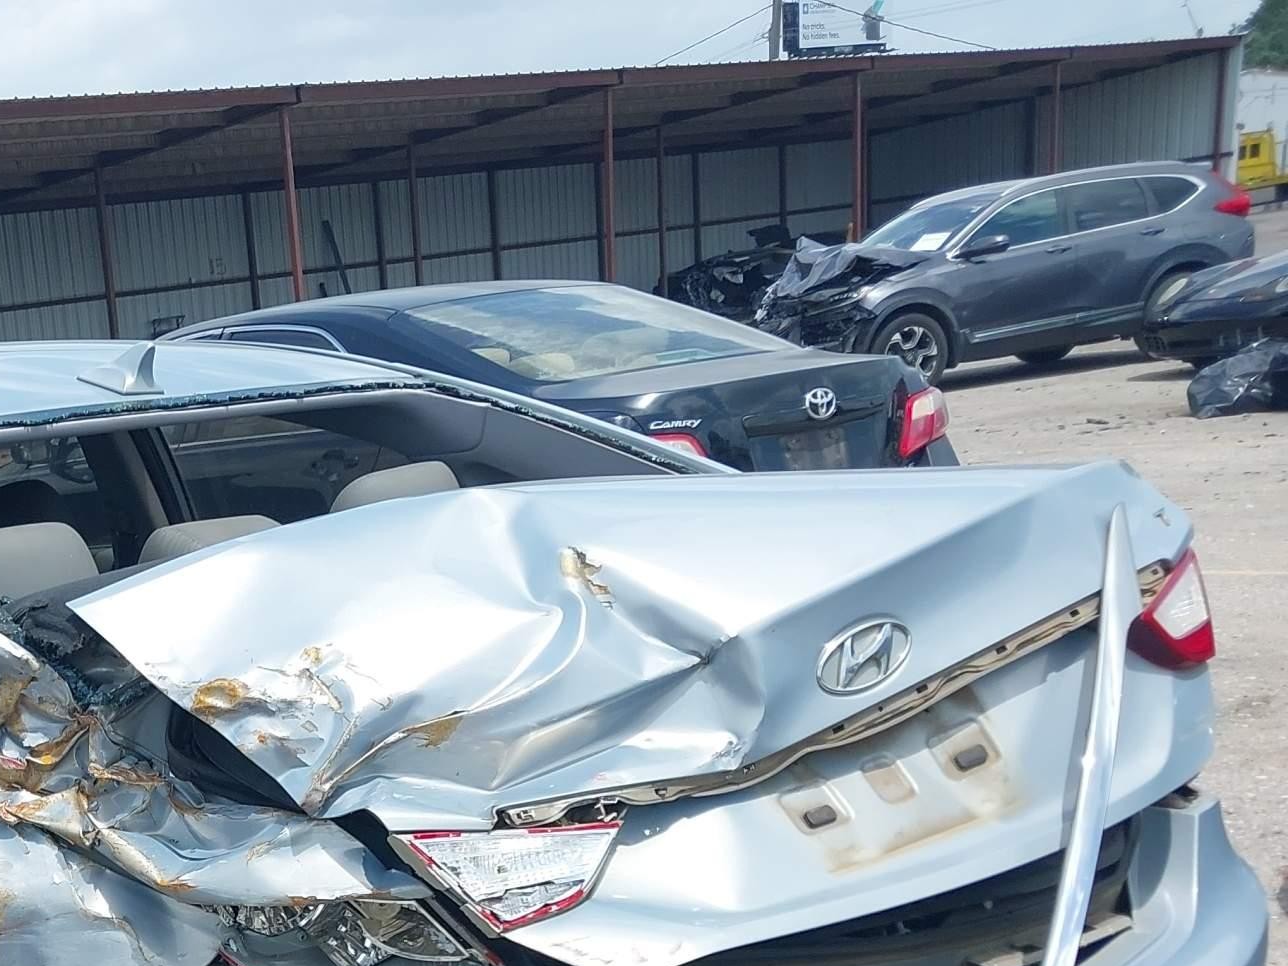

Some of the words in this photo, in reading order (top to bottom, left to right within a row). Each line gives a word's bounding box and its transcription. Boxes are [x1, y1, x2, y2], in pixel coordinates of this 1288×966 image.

[802, 33, 810, 41] No
[811, 31, 828, 40] hidden
[649, 418, 703, 430] CAMRY
